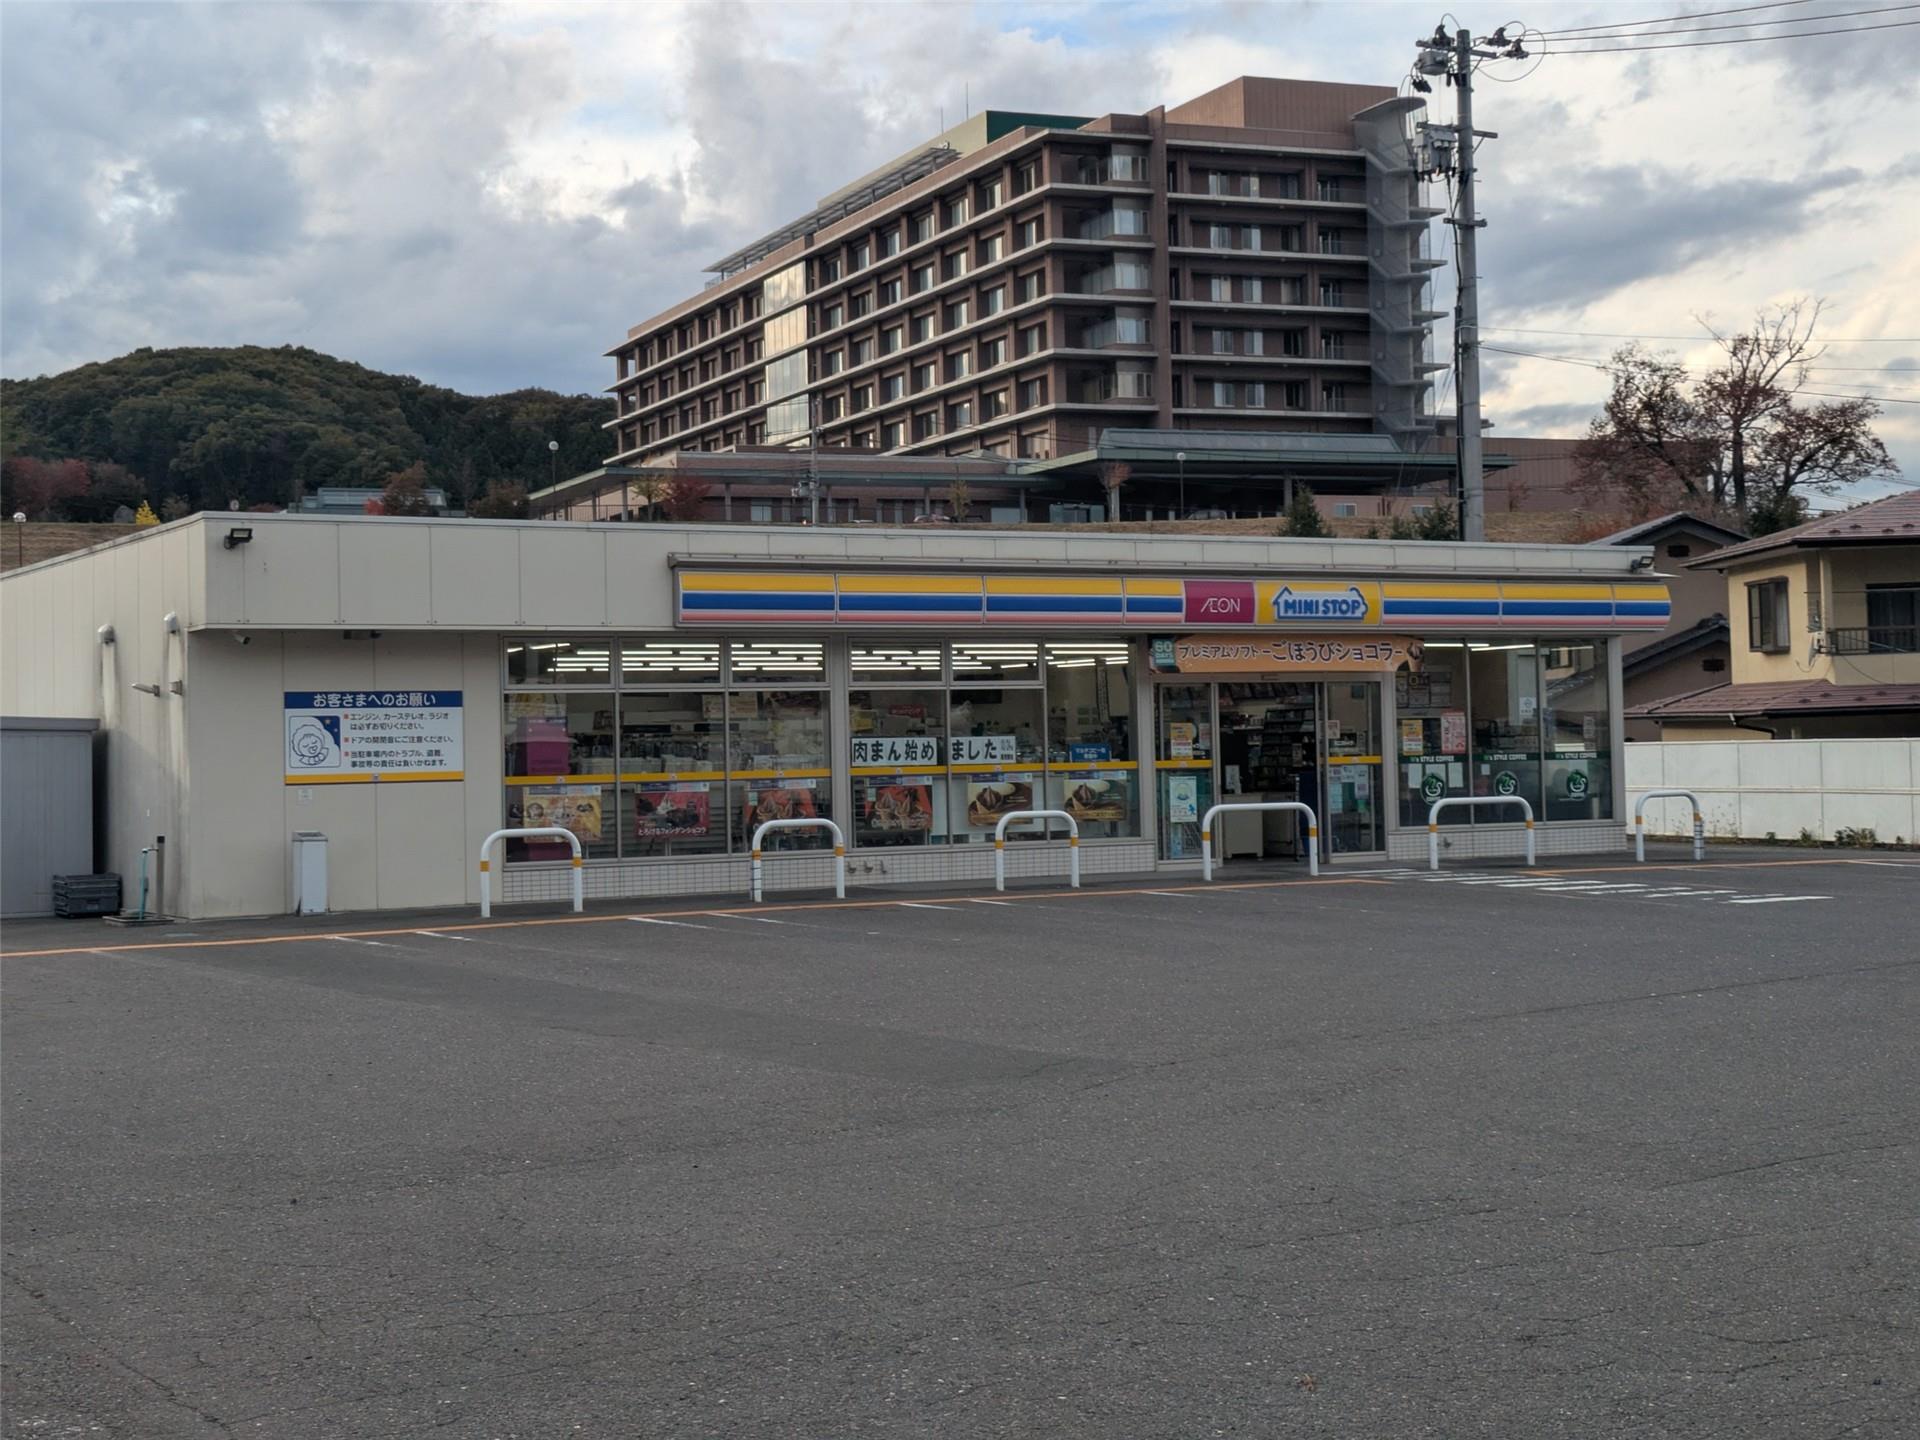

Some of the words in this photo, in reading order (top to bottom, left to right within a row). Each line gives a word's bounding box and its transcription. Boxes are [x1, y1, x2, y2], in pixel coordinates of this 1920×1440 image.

[313, 693, 436, 707] お客さまへのお願い
[853, 740, 935, 762] 肉まん始め
[951, 739, 997, 760] ました
